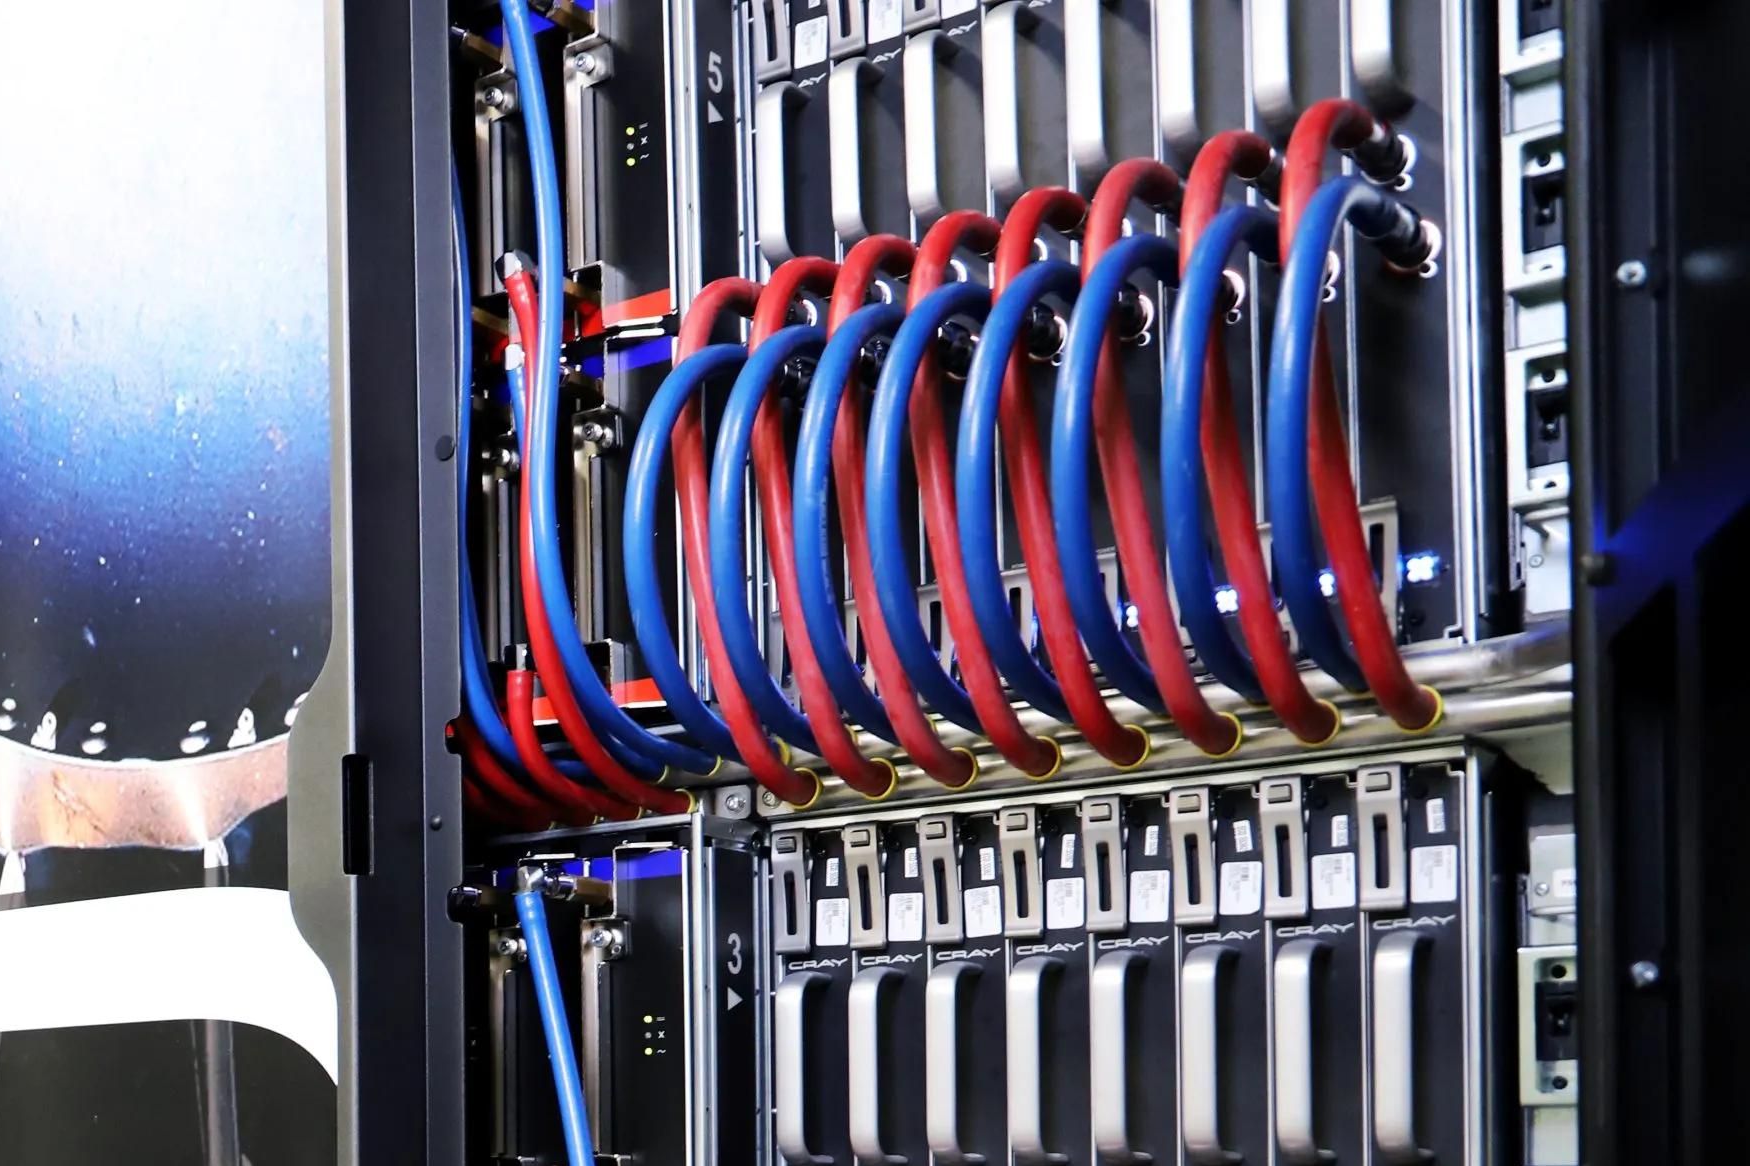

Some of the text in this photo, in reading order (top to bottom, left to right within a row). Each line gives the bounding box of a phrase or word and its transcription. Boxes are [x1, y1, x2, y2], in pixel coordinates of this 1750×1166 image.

[708, 52, 723, 93] 5
[1276, 922, 1354, 937] CRAY
[1373, 915, 1456, 932] CRAY
[1098, 936, 1169, 949] CRAY
[1185, 929, 1260, 944] CRAY
[726, 933, 742, 974] 3
[936, 948, 1001, 961] CRAY
[1016, 941, 1084, 956] CRAY
[788, 957, 848, 971] CRAY
[860, 953, 923, 967] CRAY
